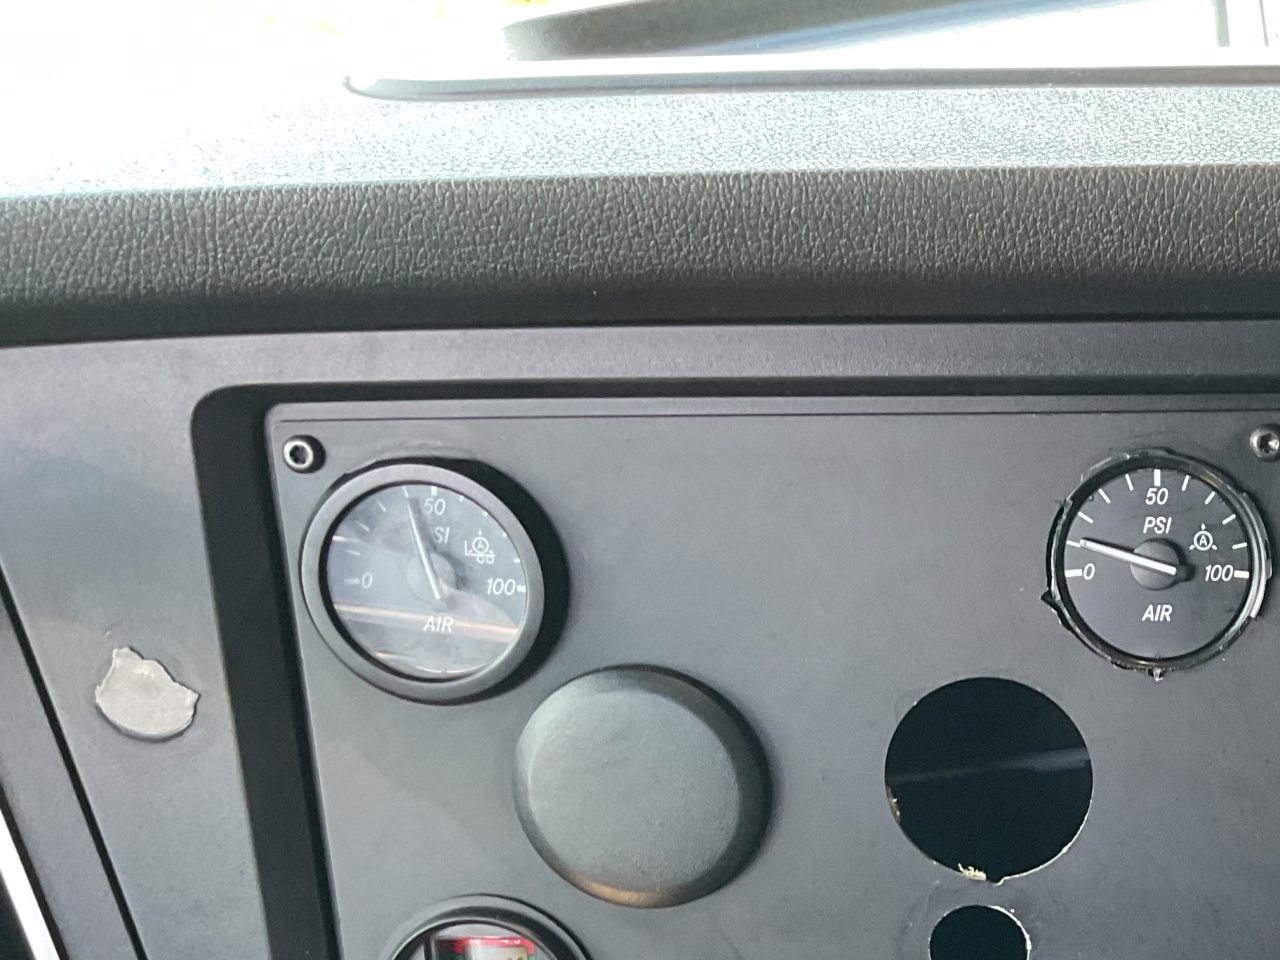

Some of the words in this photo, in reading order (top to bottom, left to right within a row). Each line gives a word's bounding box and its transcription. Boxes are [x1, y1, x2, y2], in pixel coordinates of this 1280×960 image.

[1145, 487, 1168, 505] 50
[422, 498, 446, 515] 50
[1143, 517, 1172, 534] PSI
[433, 526, 450, 545] SI
[1083, 563, 1095, 580] 0
[1205, 564, 1233, 582] 100
[361, 573, 373, 589] 0
[487, 578, 516, 595] 100
[1142, 605, 1172, 622] AIR
[423, 616, 454, 633] AIR
